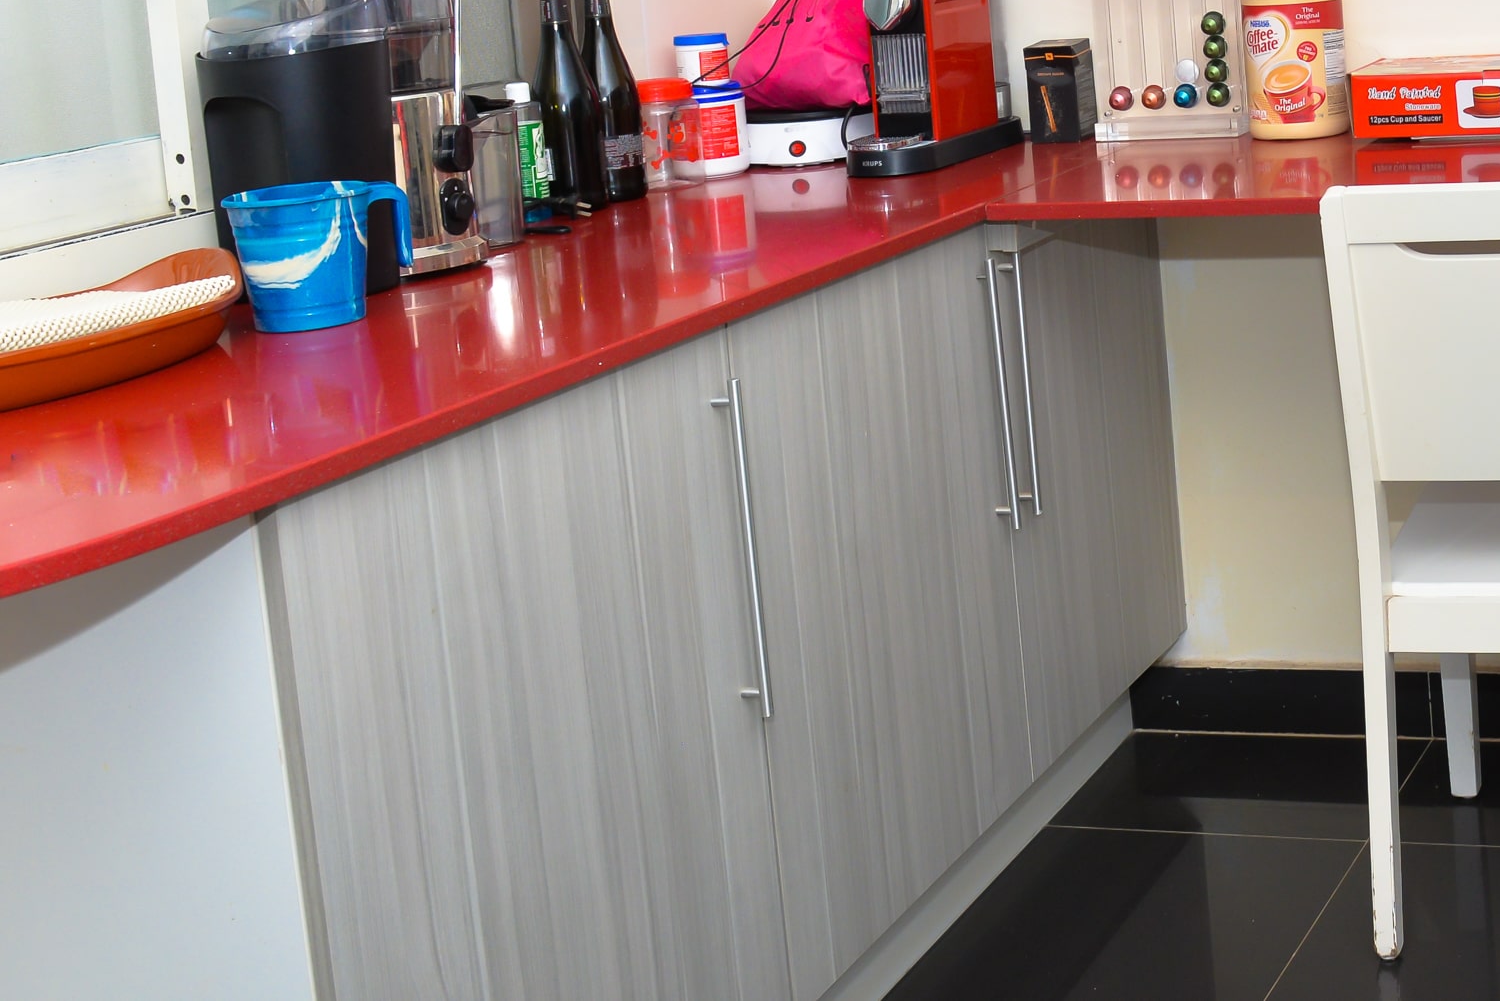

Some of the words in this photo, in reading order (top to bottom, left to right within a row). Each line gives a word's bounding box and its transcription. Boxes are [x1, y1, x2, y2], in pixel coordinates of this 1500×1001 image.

[1295, 12, 1320, 20] Original
[1252, 39, 1279, 55] mate
[1368, 87, 1396, 100] Hand
[1399, 85, 1441, 99] Painted
[1274, 97, 1306, 113] Original
[1405, 103, 1441, 111] Stoneware
[1370, 116, 1389, 124] 12pcs
[1390, 115, 1404, 123] Cup
